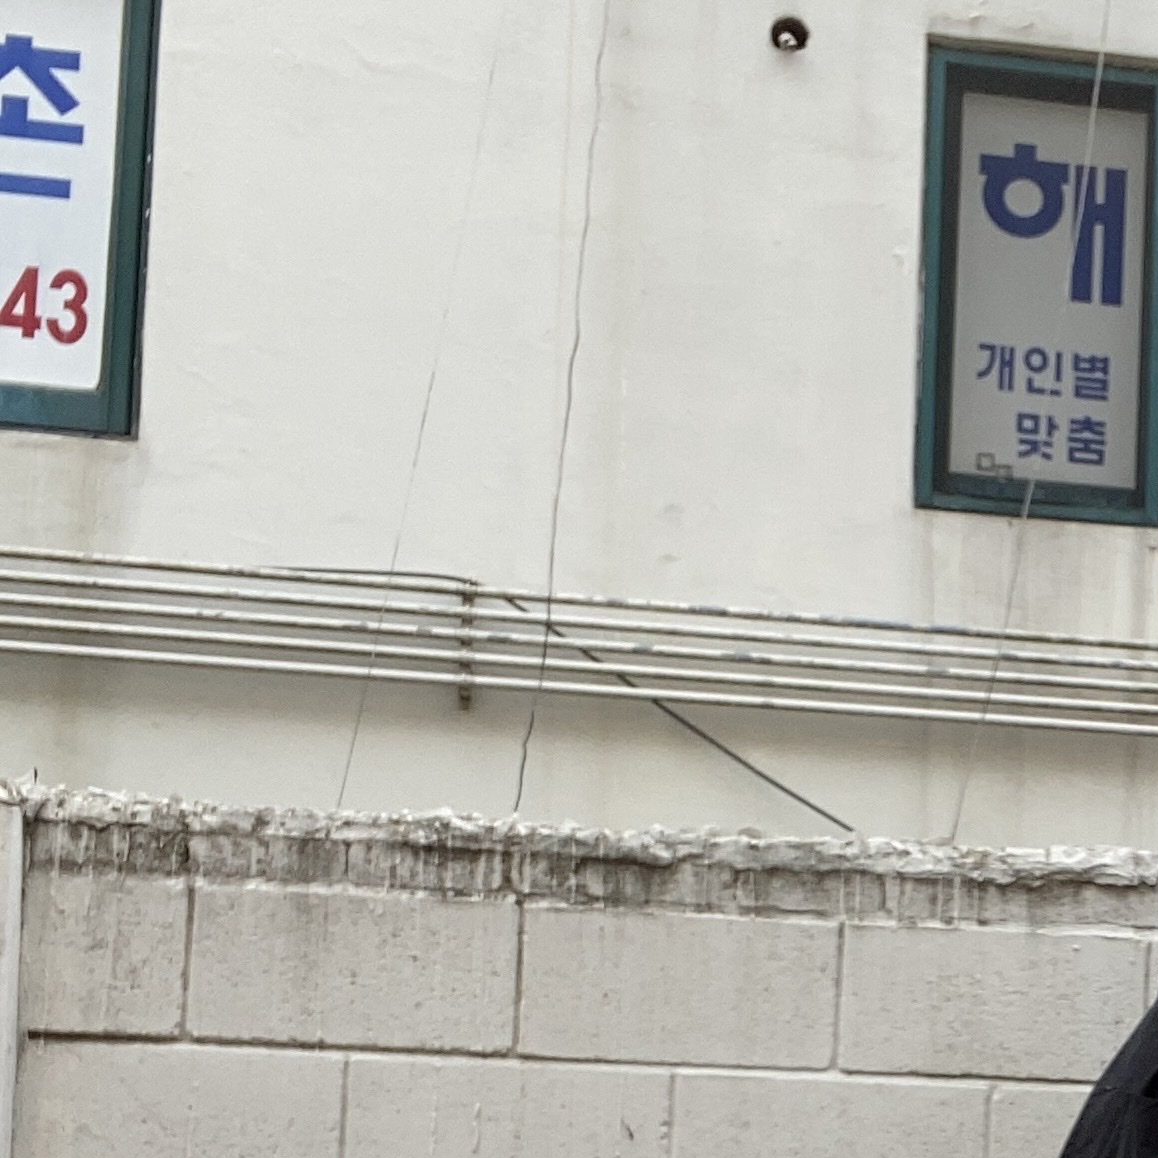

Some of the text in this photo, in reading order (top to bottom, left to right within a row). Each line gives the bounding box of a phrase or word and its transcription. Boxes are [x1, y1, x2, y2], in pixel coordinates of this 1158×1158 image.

[978, 142, 1128, 308] 해
[976, 342, 1111, 401] 개인별
[1016, 412, 1107, 466] 맞춤
